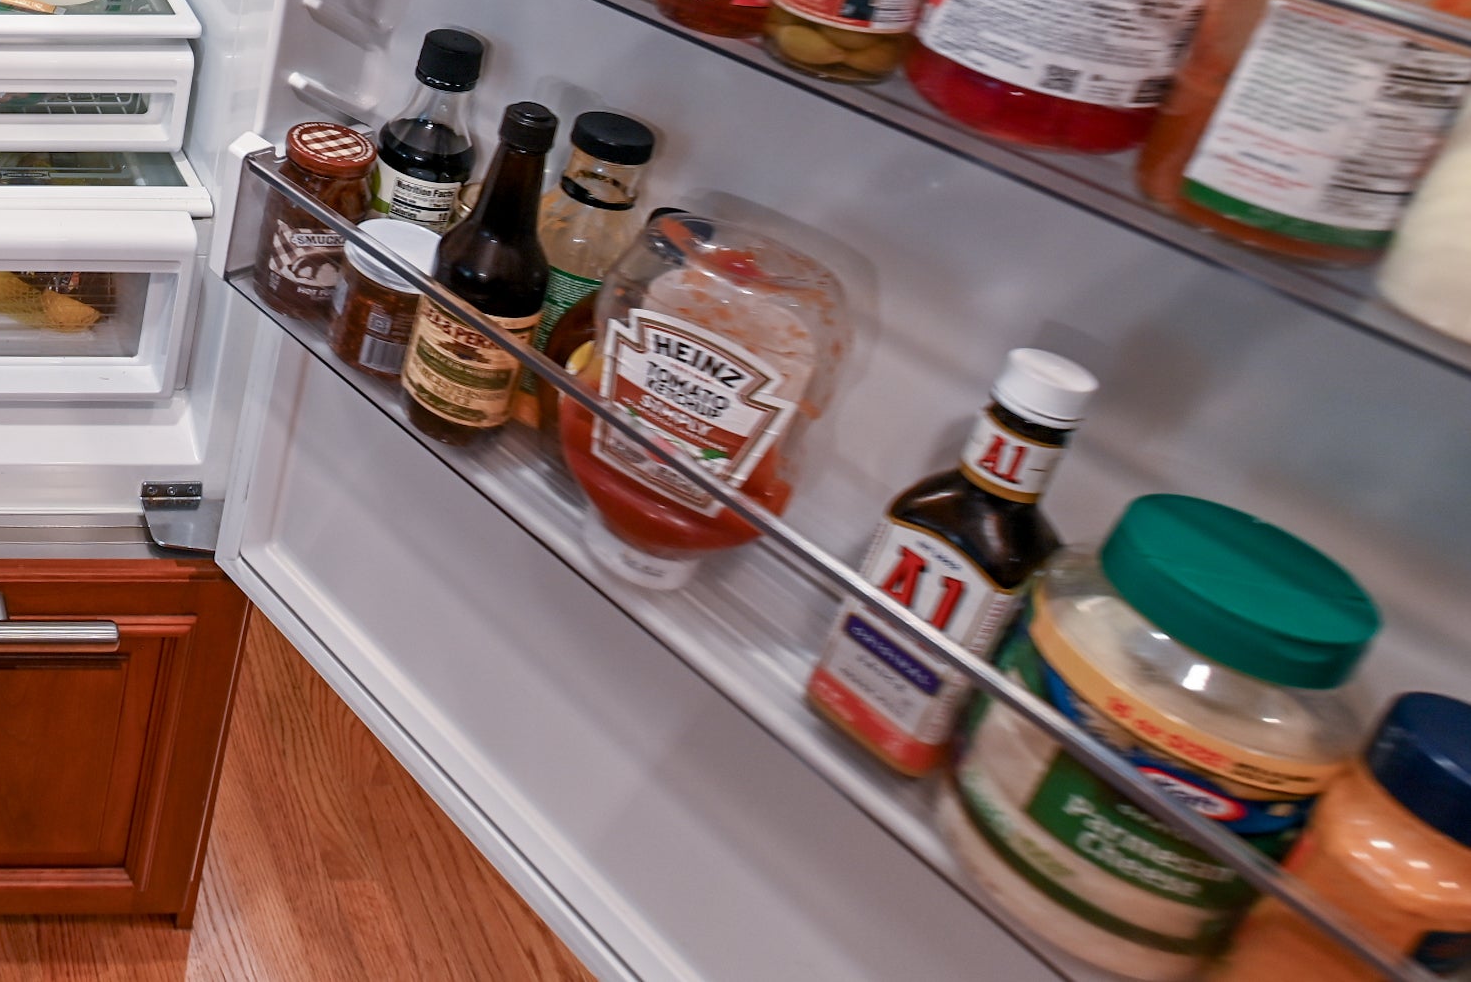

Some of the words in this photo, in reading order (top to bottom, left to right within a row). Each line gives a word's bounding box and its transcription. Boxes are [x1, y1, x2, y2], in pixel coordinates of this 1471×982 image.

[396, 179, 432, 197] Nutrition
[433, 189, 455, 198] Facts
[391, 205, 417, 219] Calories
[652, 333, 746, 389] HEINZ
[645, 378, 723, 419] KETCHUP
[646, 360, 729, 411] TOMATO
[640, 394, 713, 436] SIMPLY
[1062, 793, 1234, 882] Parmesan
[1076, 830, 1203, 896] Cheese
